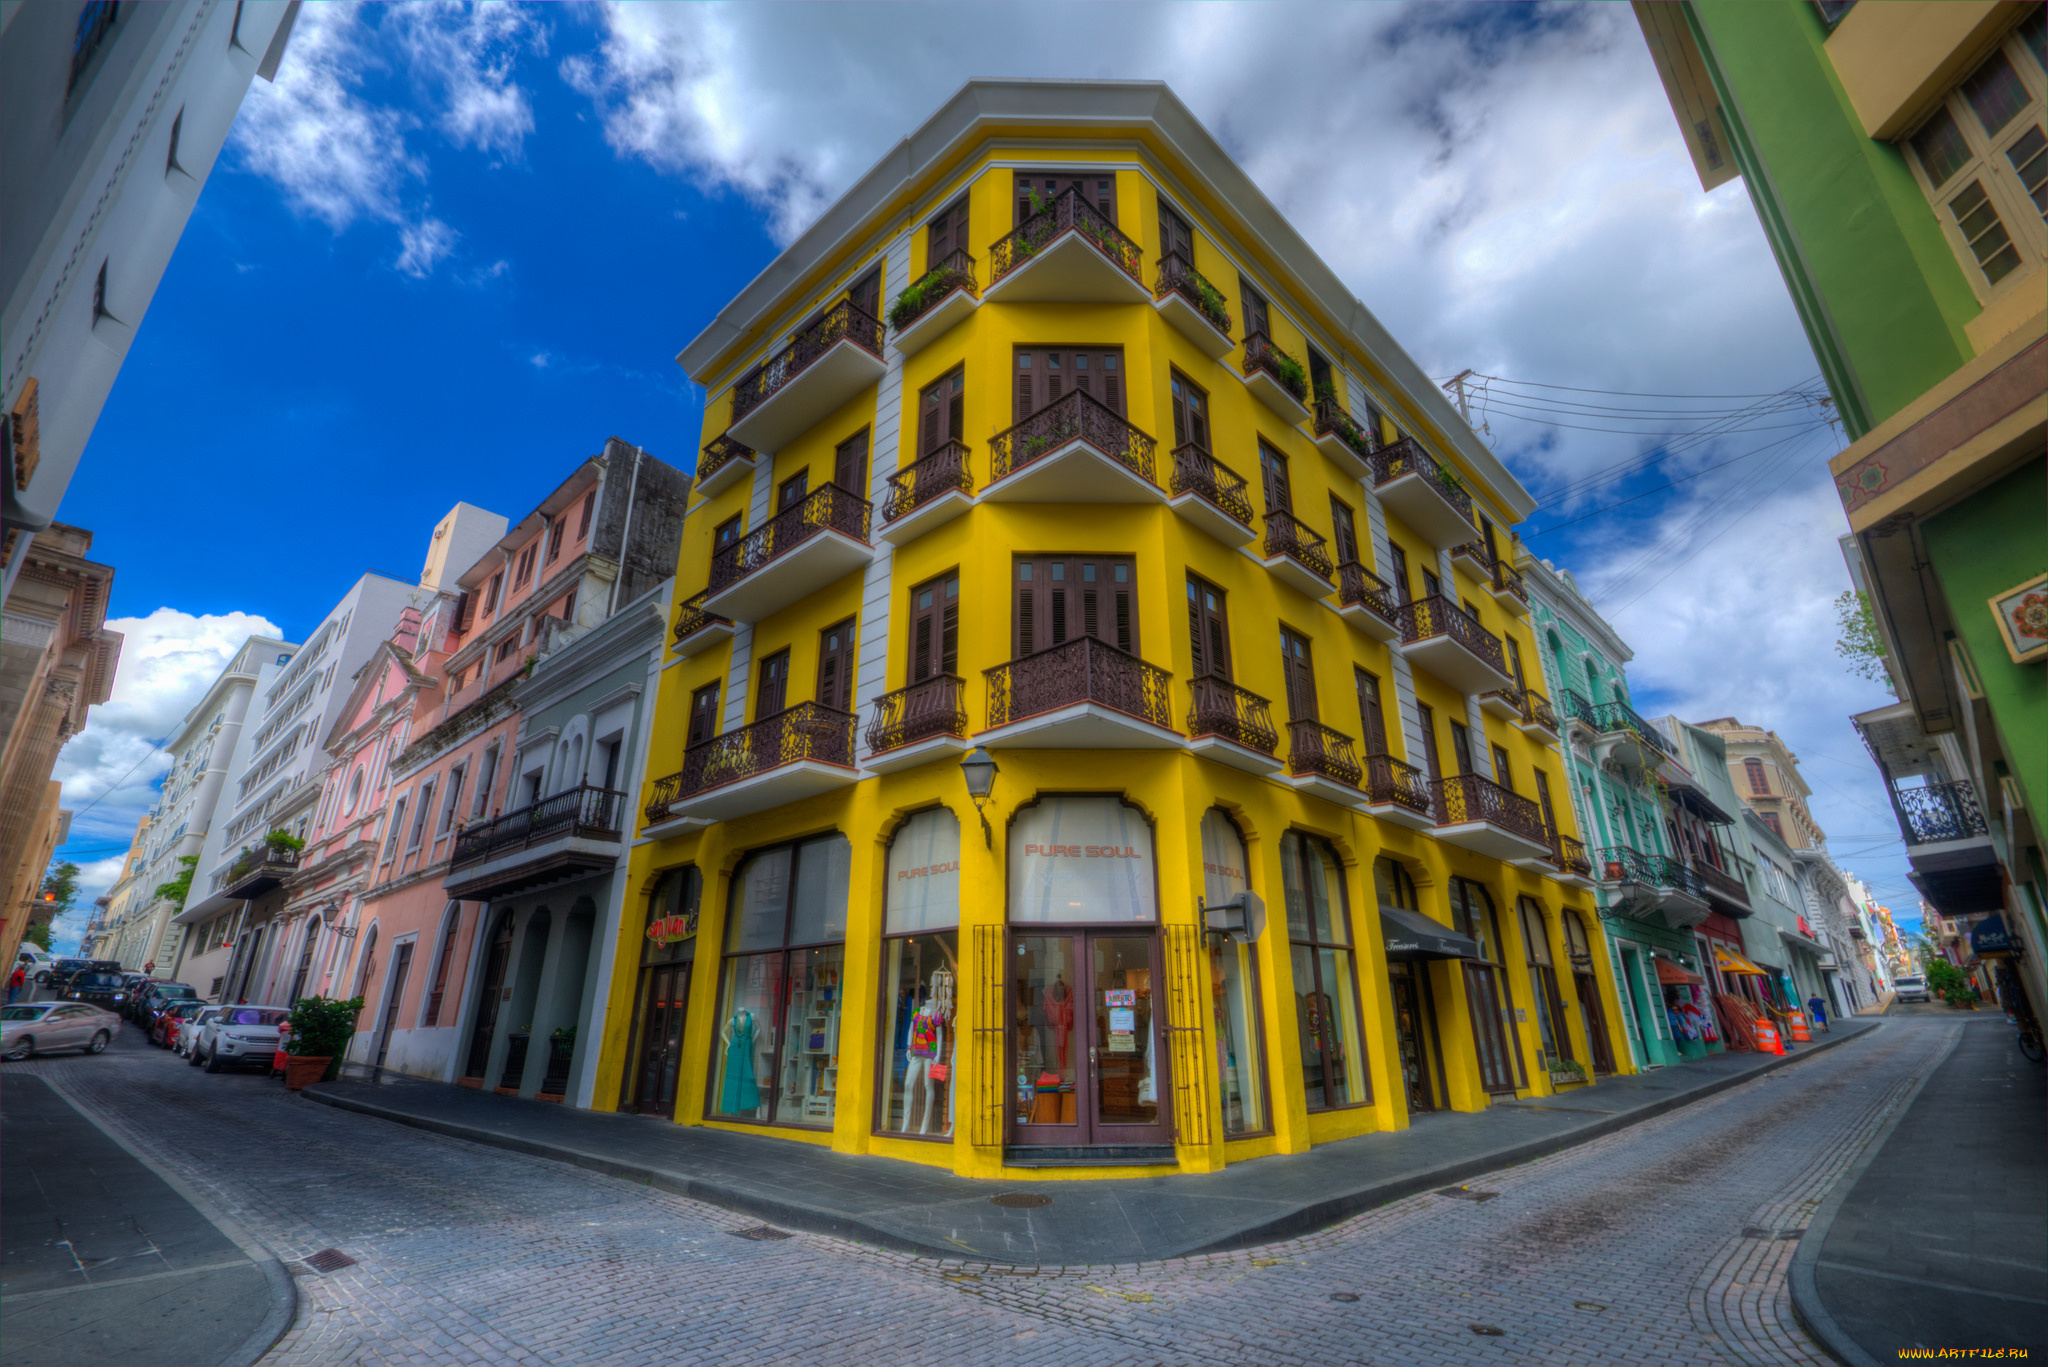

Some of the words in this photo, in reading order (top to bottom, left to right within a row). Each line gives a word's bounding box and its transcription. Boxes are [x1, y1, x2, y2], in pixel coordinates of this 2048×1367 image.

[1025, 844, 1082, 858] PURE
[1084, 845, 1142, 859] SOUL
[897, 866, 929, 881] PURE
[930, 860, 961, 876] SOUL
[1203, 862, 1216, 874] RE
[1218, 865, 1244, 880] SOUL
